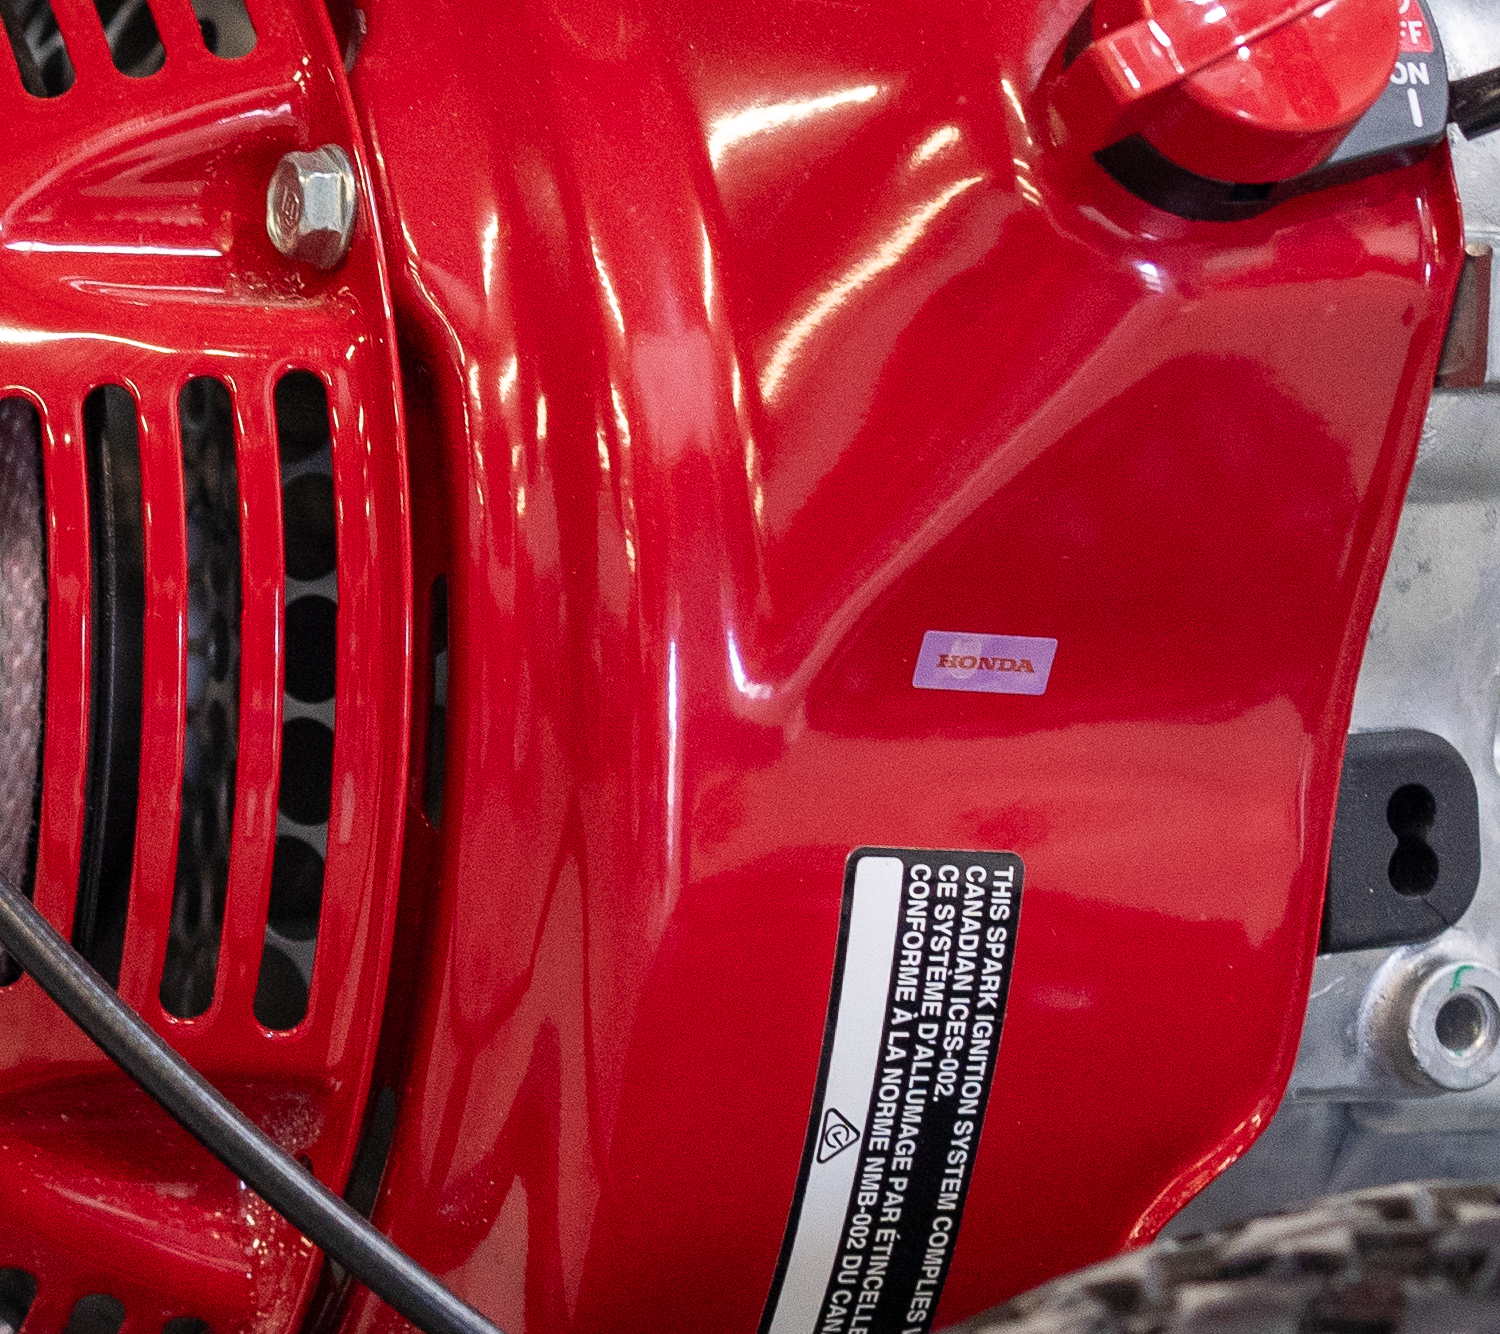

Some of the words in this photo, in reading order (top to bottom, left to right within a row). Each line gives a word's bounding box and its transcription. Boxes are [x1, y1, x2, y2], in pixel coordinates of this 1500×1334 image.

[937, 653, 1036, 674] HONDA
[937, 865, 960, 898] CE
[990, 866, 1014, 921] THIS
[895, 864, 932, 1001] CONFORME
[921, 903, 955, 1017] SYSTÈME
[948, 866, 987, 991] CANADIAN
[977, 927, 1007, 1009] SPARK
[886, 1031, 909, 1062] LA
[891, 1007, 918, 1026] À
[932, 997, 970, 1102] ICES-002.
[892, 1023, 939, 1170] D'ALLUMAGE
[958, 1015, 994, 1115] IGNITION
[869, 1068, 903, 1151] NORME
[847, 1157, 885, 1250] NMB-002
[880, 1177, 908, 1222] PAR
[937, 1120, 973, 1209] SYSTEM
[838, 1255, 862, 1284] DU
[907, 1216, 952, 1322] COMPLIES
